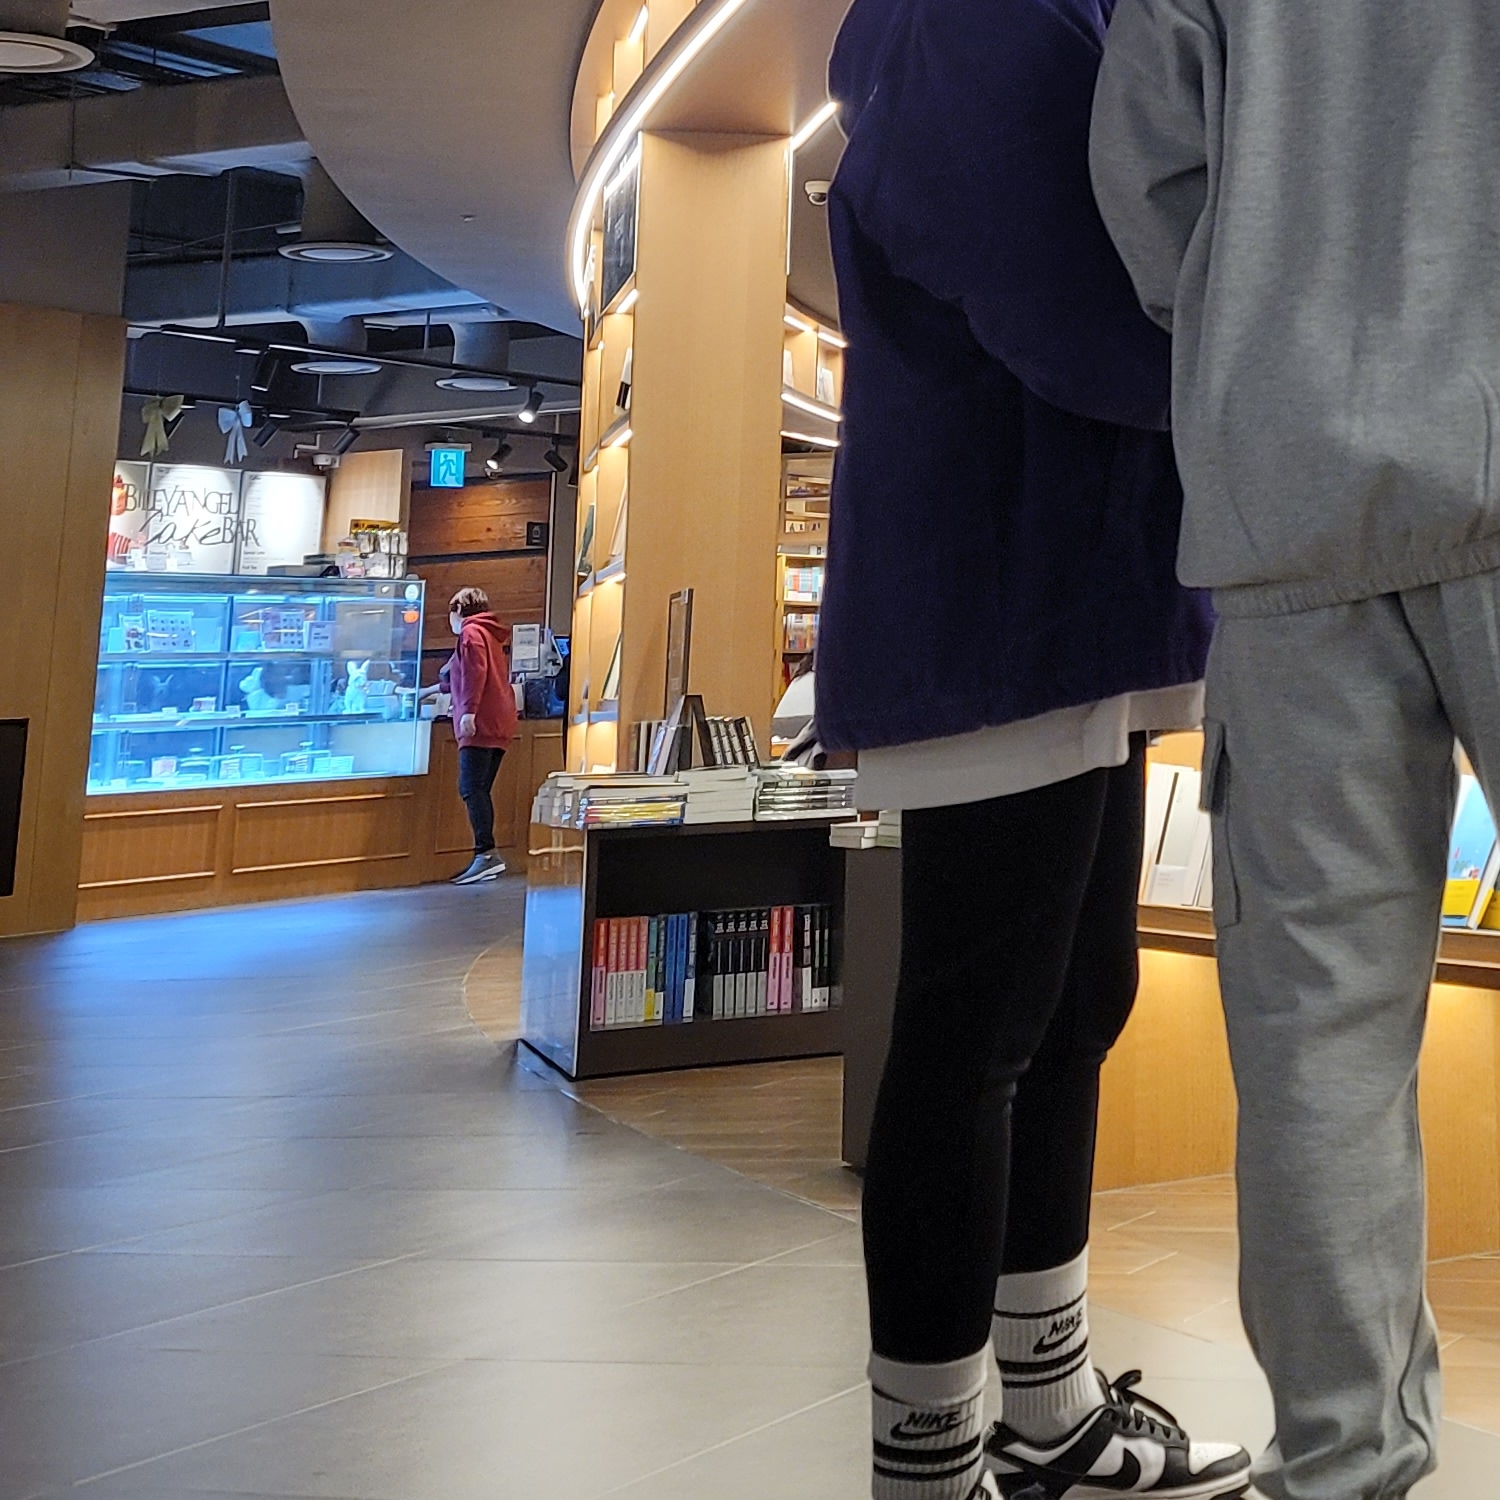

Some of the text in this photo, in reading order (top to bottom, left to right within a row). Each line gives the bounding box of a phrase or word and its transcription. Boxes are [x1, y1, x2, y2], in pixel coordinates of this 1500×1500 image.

[222, 516, 261, 547] BAR
[1047, 1306, 1085, 1337] NIKE
[904, 1410, 963, 1428] NIKE
